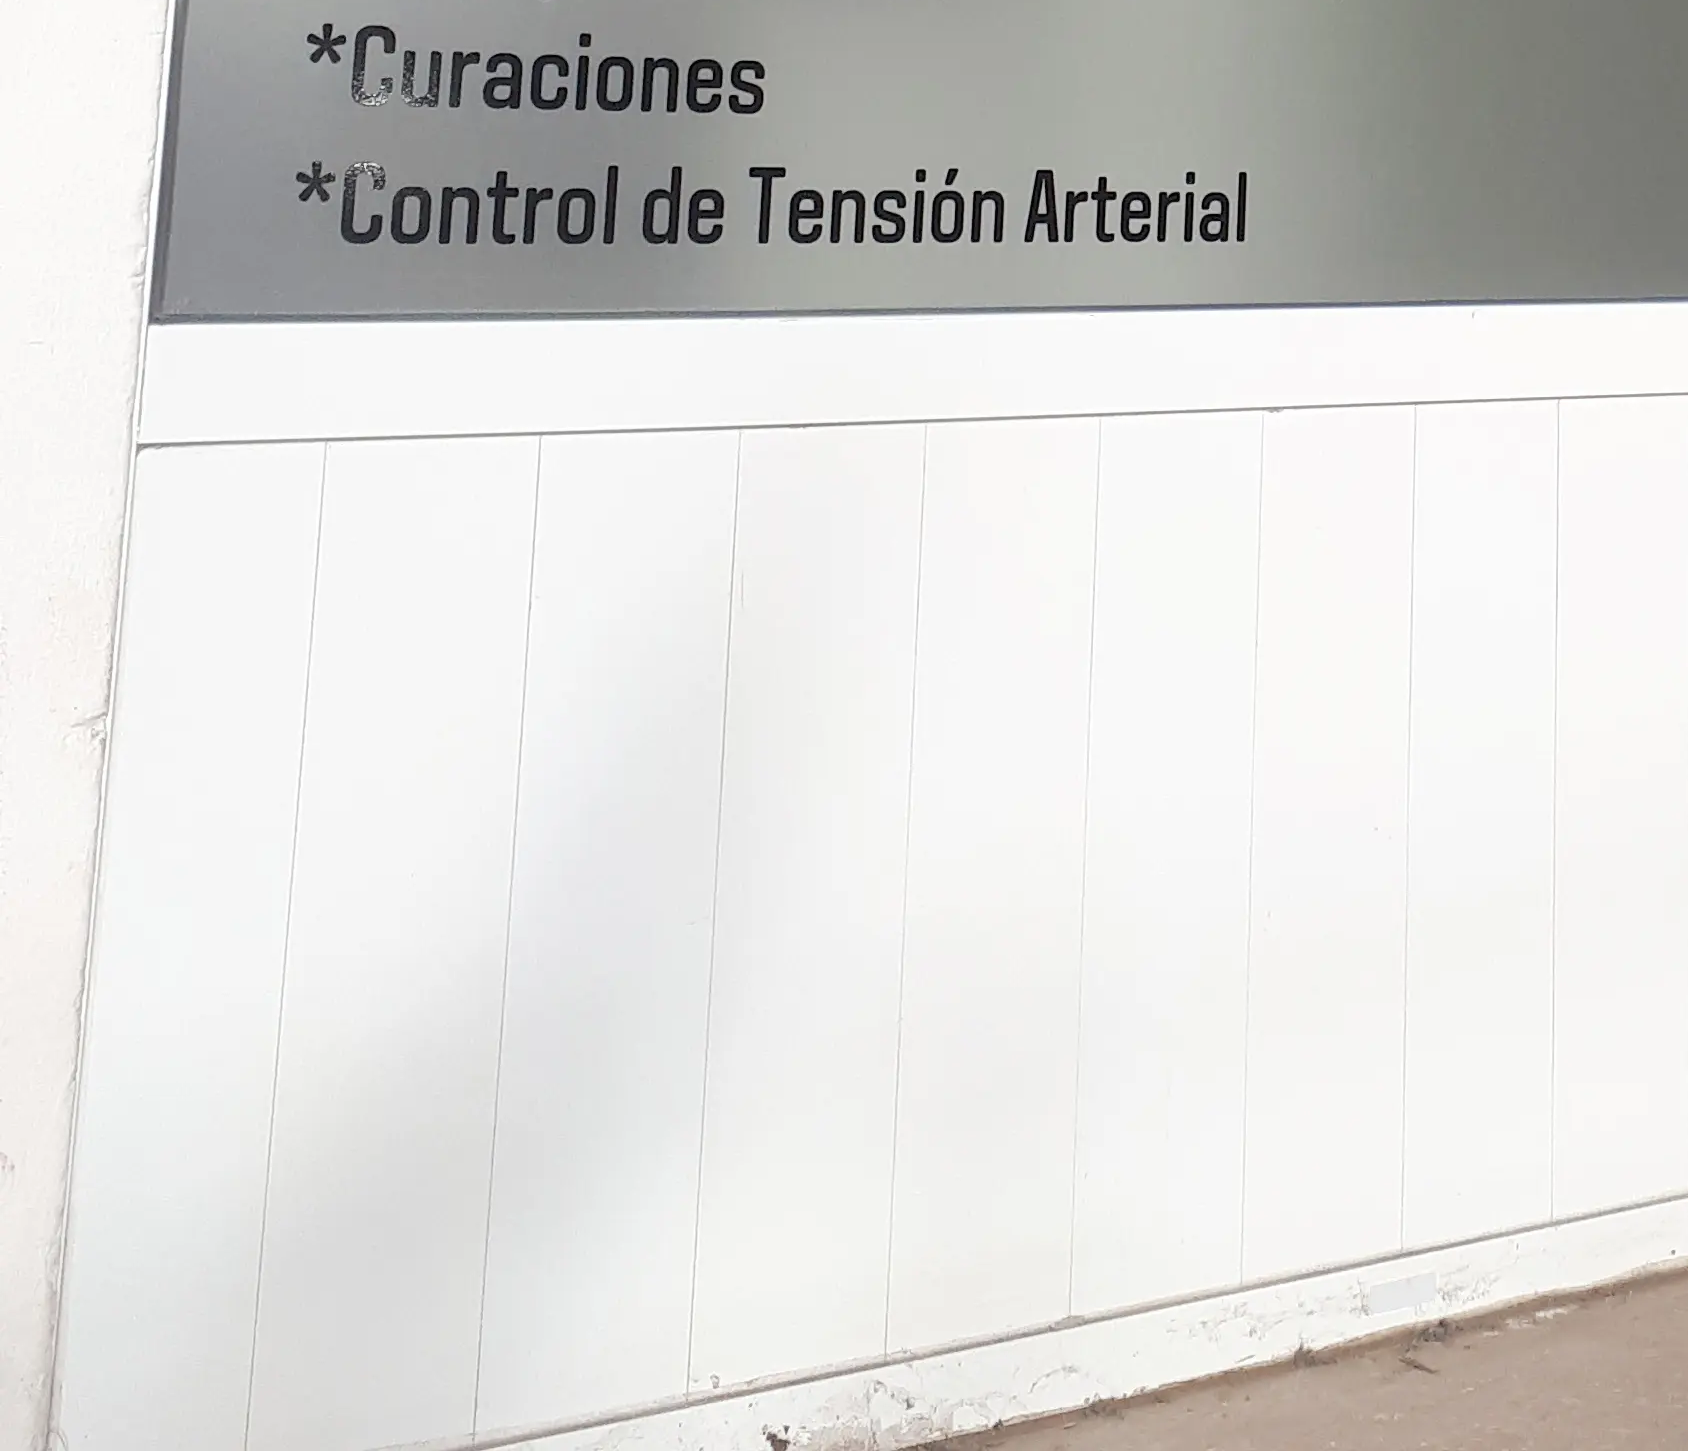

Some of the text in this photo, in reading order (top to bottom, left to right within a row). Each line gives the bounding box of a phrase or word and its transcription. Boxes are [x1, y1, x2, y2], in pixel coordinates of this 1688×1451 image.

[642, 166, 725, 245] de
[749, 167, 1004, 244] Tensión
[1024, 169, 1248, 243] Arterial
